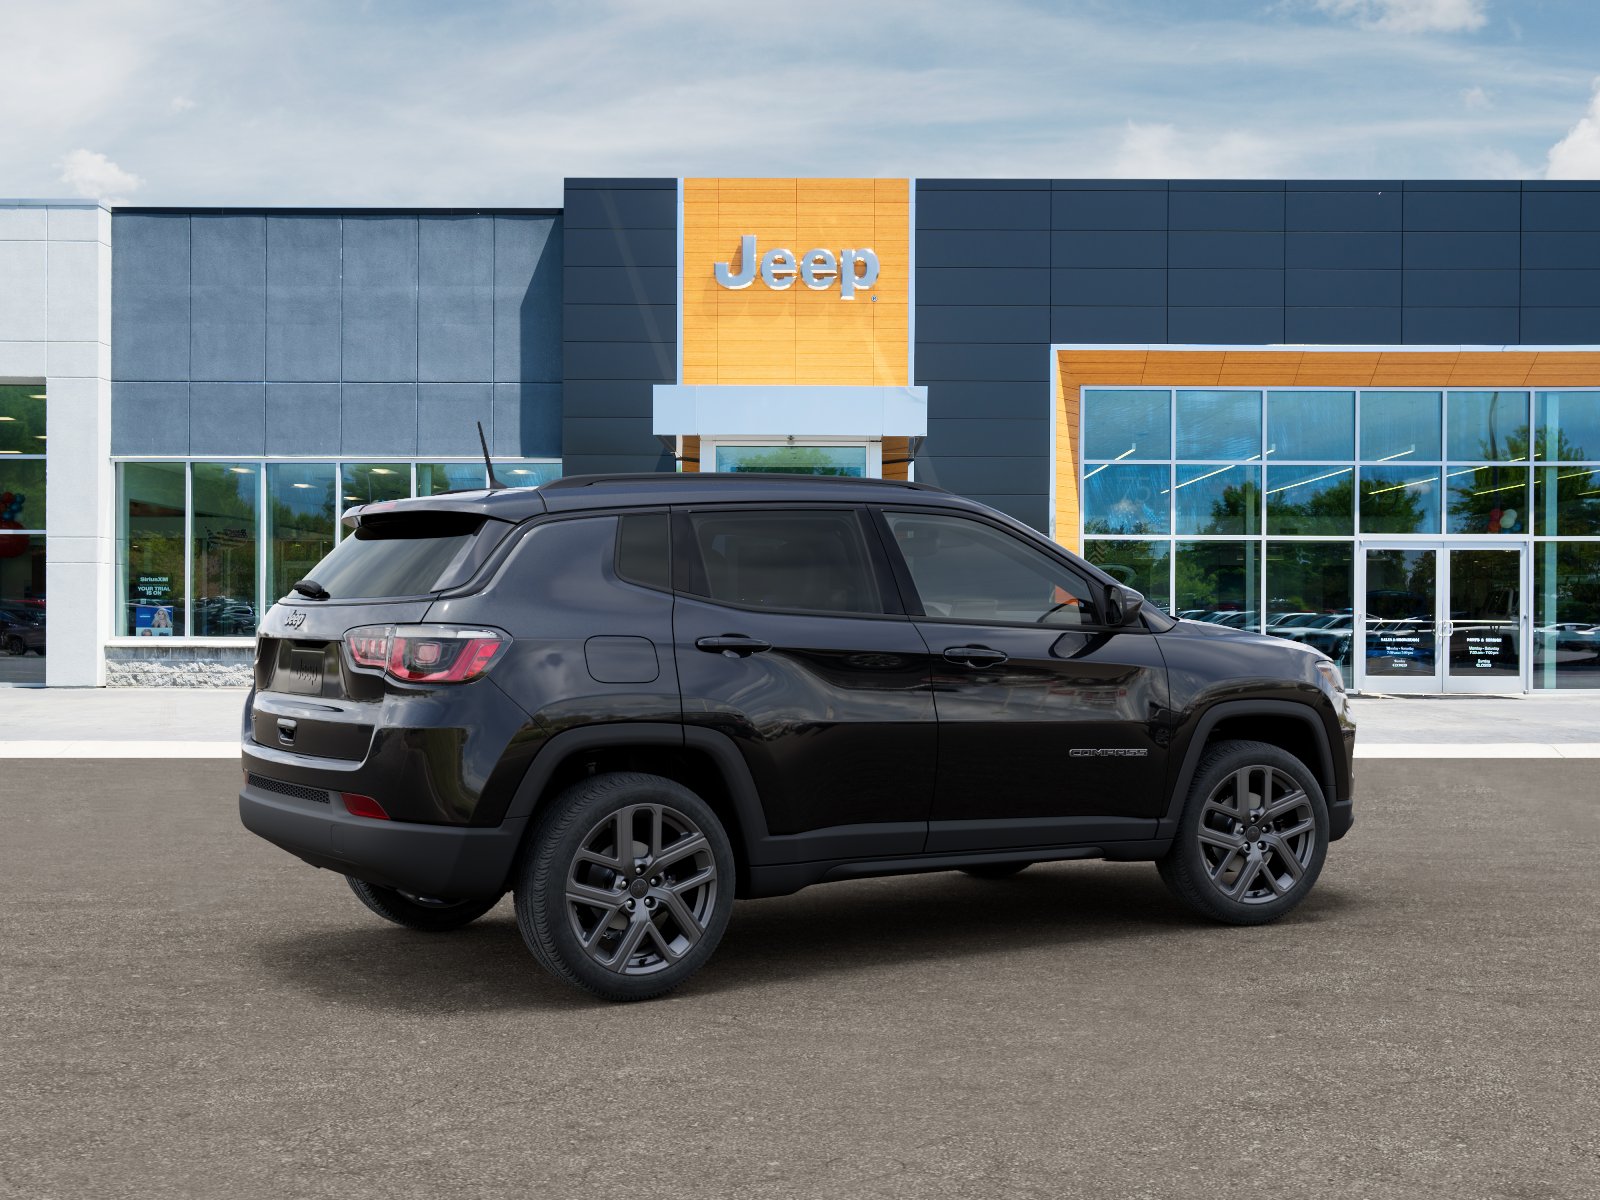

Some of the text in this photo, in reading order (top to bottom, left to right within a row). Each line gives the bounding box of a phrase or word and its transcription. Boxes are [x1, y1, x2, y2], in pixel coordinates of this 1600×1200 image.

[714, 234, 881, 301] Jeep
[284, 609, 307, 630] Jeep
[1069, 748, 1148, 757] COMPASS
